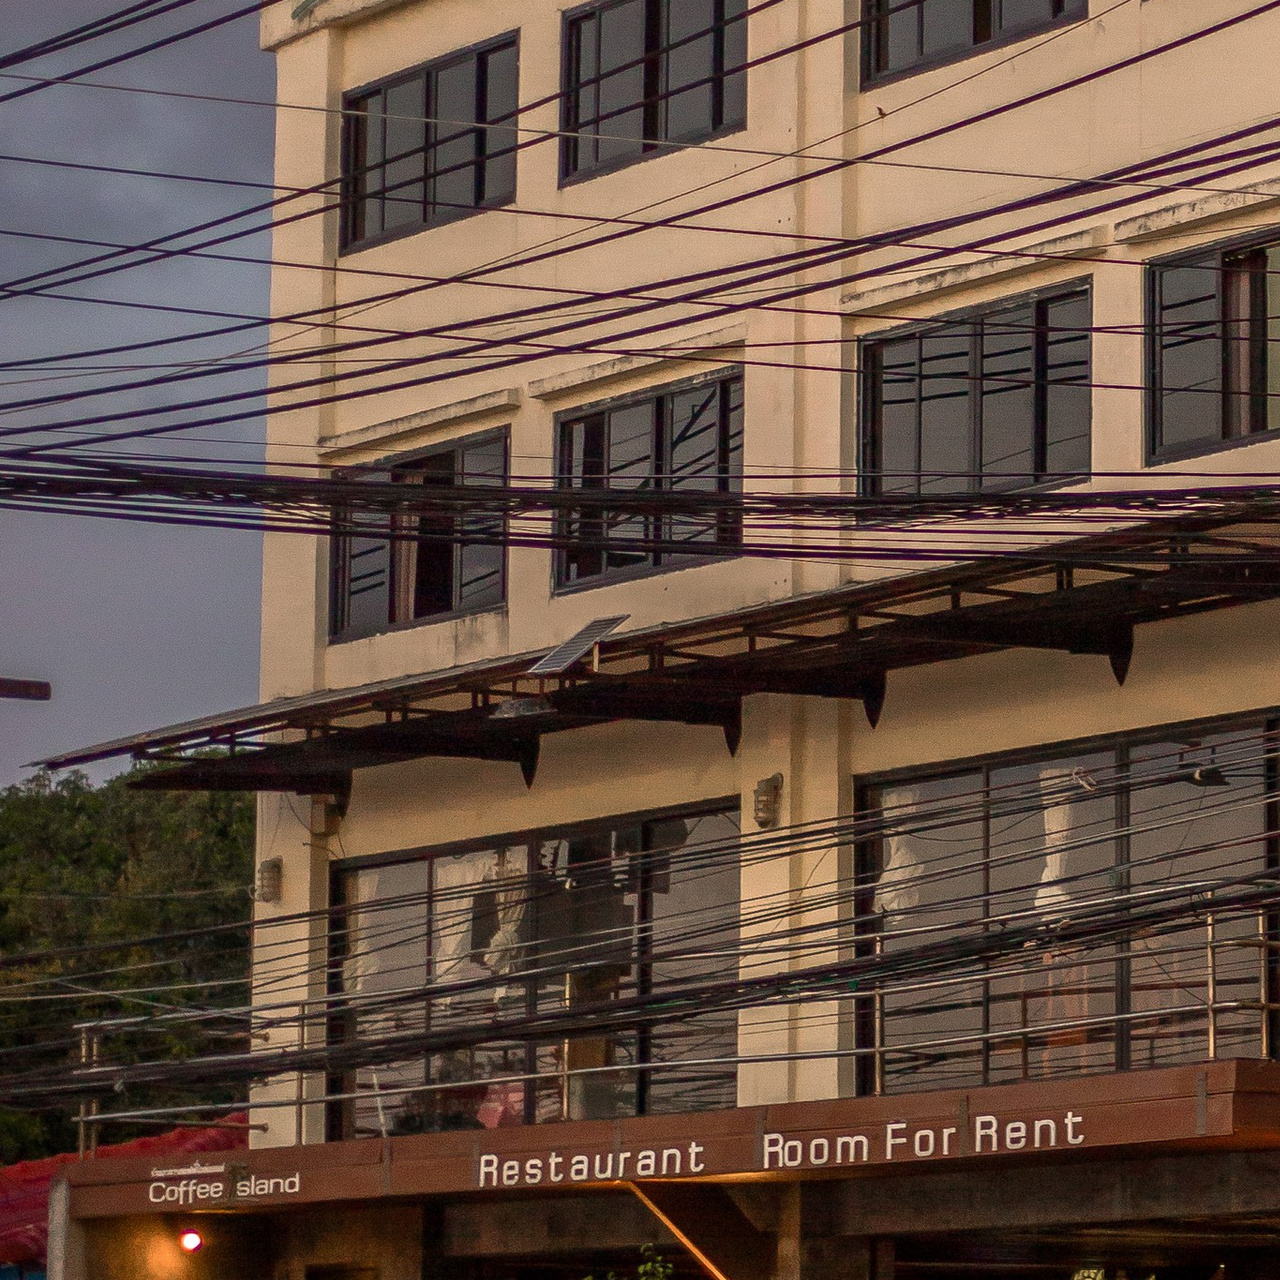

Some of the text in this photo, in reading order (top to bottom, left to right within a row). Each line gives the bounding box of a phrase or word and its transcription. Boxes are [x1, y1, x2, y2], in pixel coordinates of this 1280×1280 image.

[478, 1111, 1085, 1188] Restaurant Room For Rent
[149, 1179, 224, 1205] Coffee
